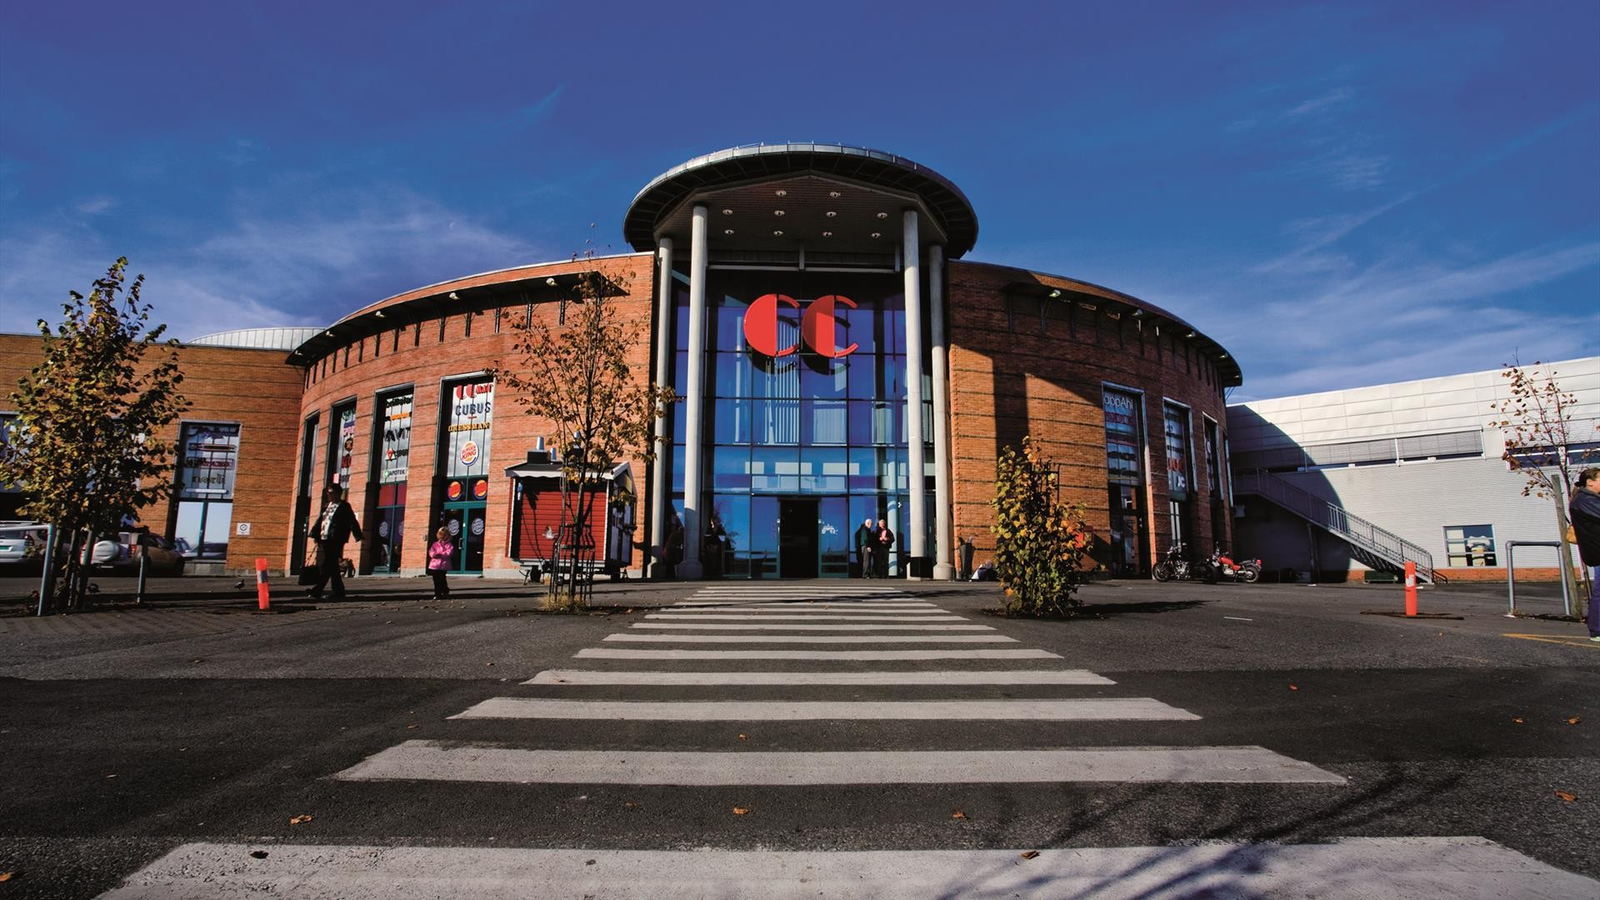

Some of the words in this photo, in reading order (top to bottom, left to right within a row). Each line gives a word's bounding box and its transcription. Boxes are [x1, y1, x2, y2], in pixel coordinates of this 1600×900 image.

[743, 293, 859, 358] CC
[455, 402, 491, 416] CUBUS
[461, 449, 477, 460] KING
